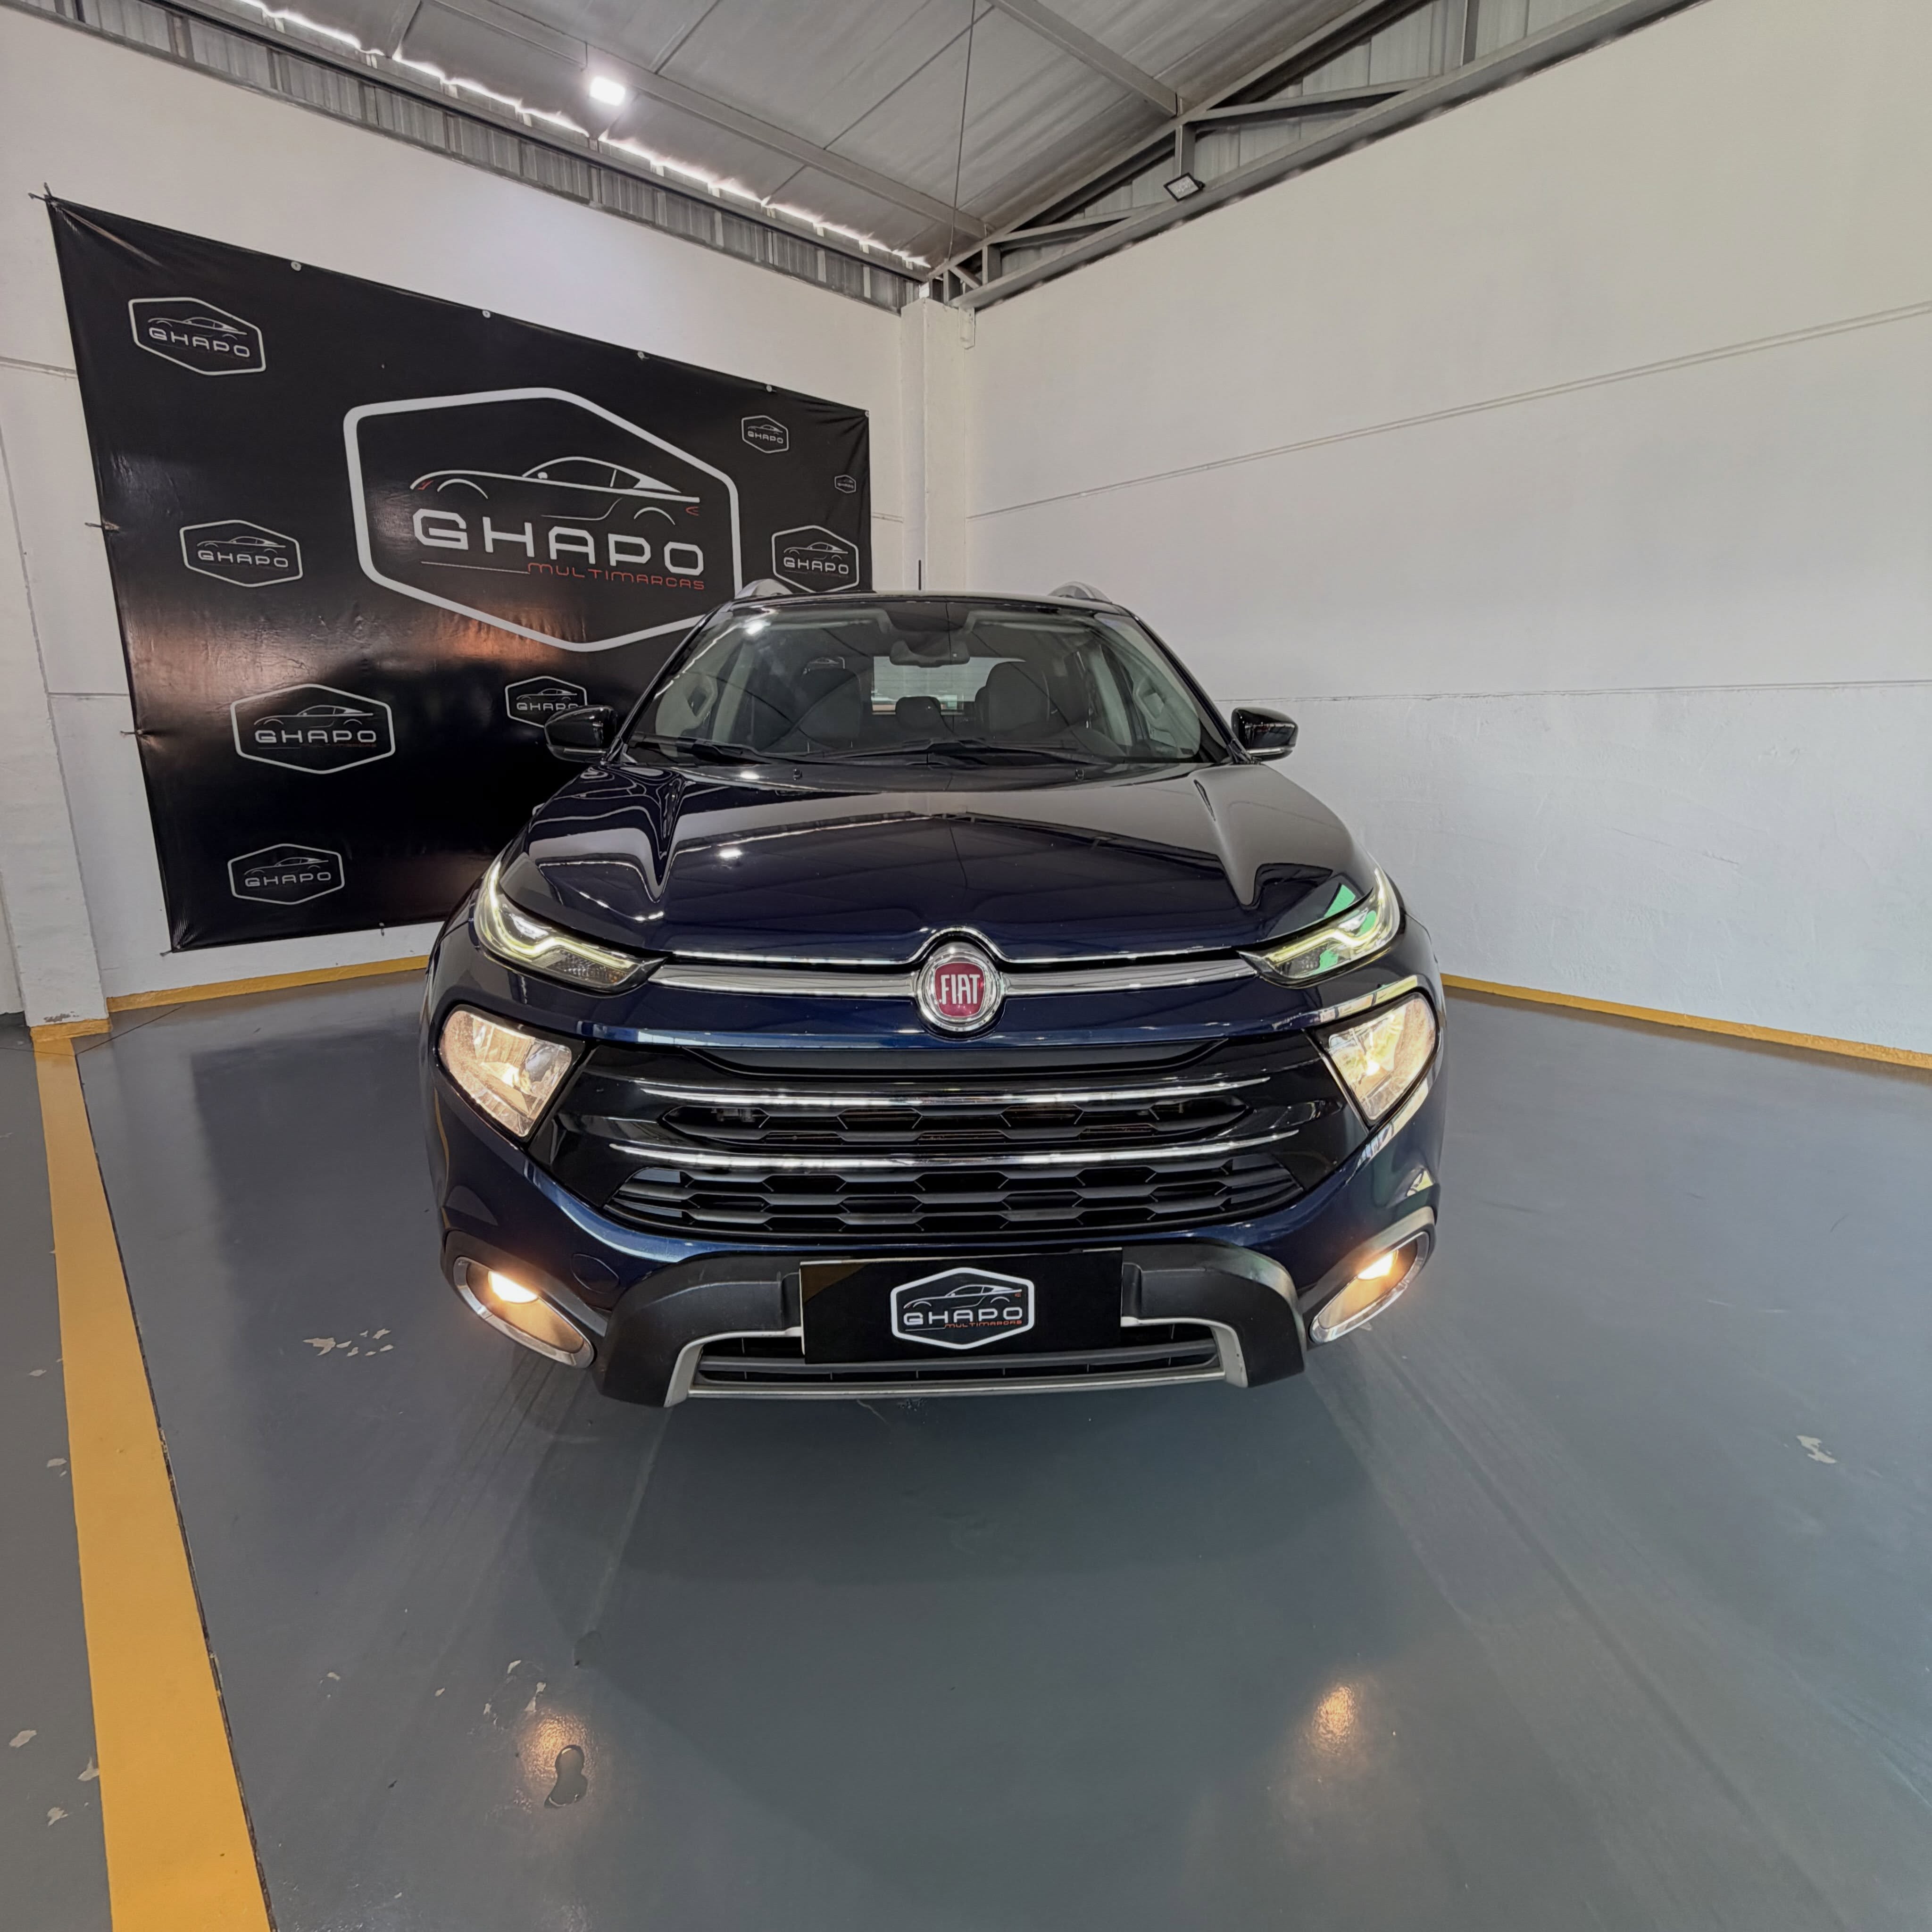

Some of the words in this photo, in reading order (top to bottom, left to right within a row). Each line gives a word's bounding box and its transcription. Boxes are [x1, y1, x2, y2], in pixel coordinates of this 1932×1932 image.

[149, 327, 250, 358] GHAPO
[748, 431, 783, 444] GHAPO
[413, 508, 703, 575] GHAPO
[198, 550, 289, 567] GHAPO
[783, 557, 849, 575] GHAPO
[528, 563, 704, 590] MULTIMARCAS
[255, 730, 376, 743] GHAPO
[245, 872, 331, 887] GHAPO
[941, 974, 980, 1004] FIAT
[903, 1307, 1023, 1325] GHAPO
